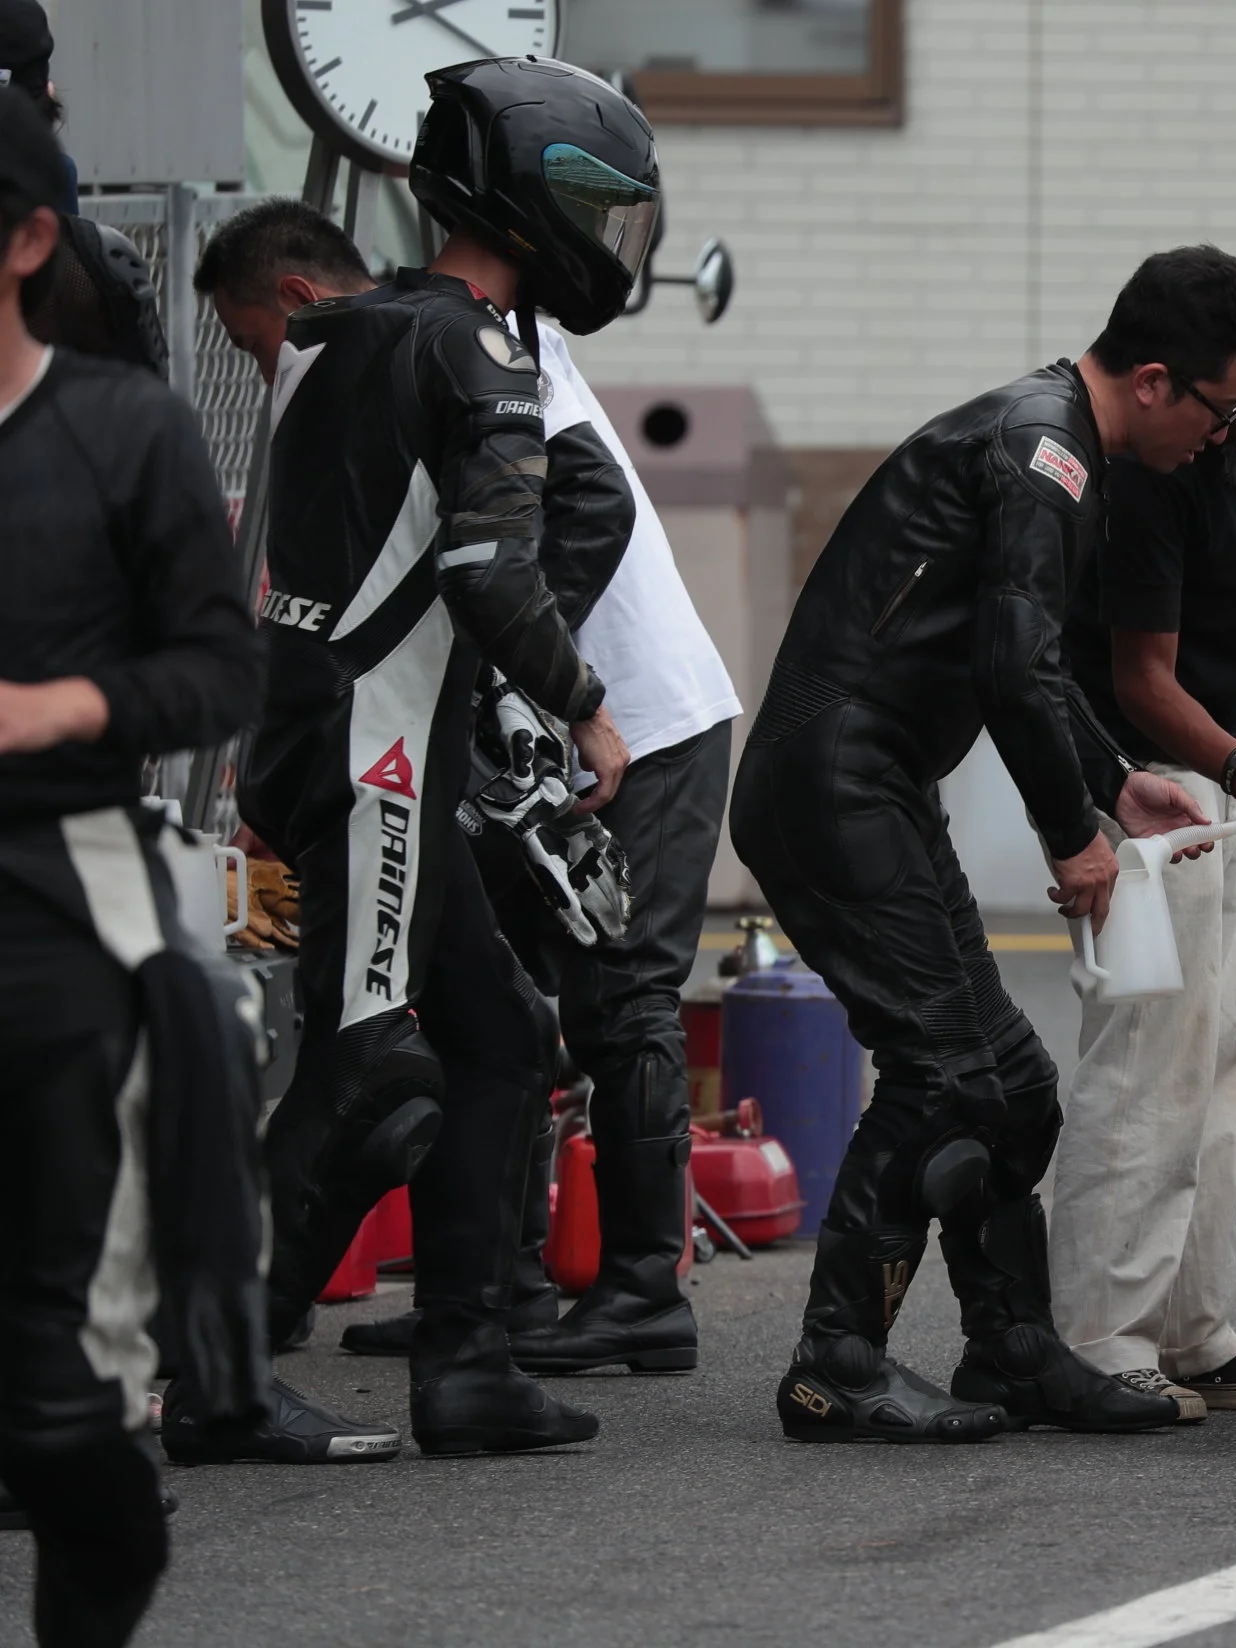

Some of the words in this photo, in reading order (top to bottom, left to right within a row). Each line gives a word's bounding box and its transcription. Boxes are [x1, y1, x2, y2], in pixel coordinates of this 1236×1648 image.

[1039, 448, 1085, 489] NANKAI
[455, 806, 482, 834] SHOE
[366, 799, 410, 1002] DAINESE
